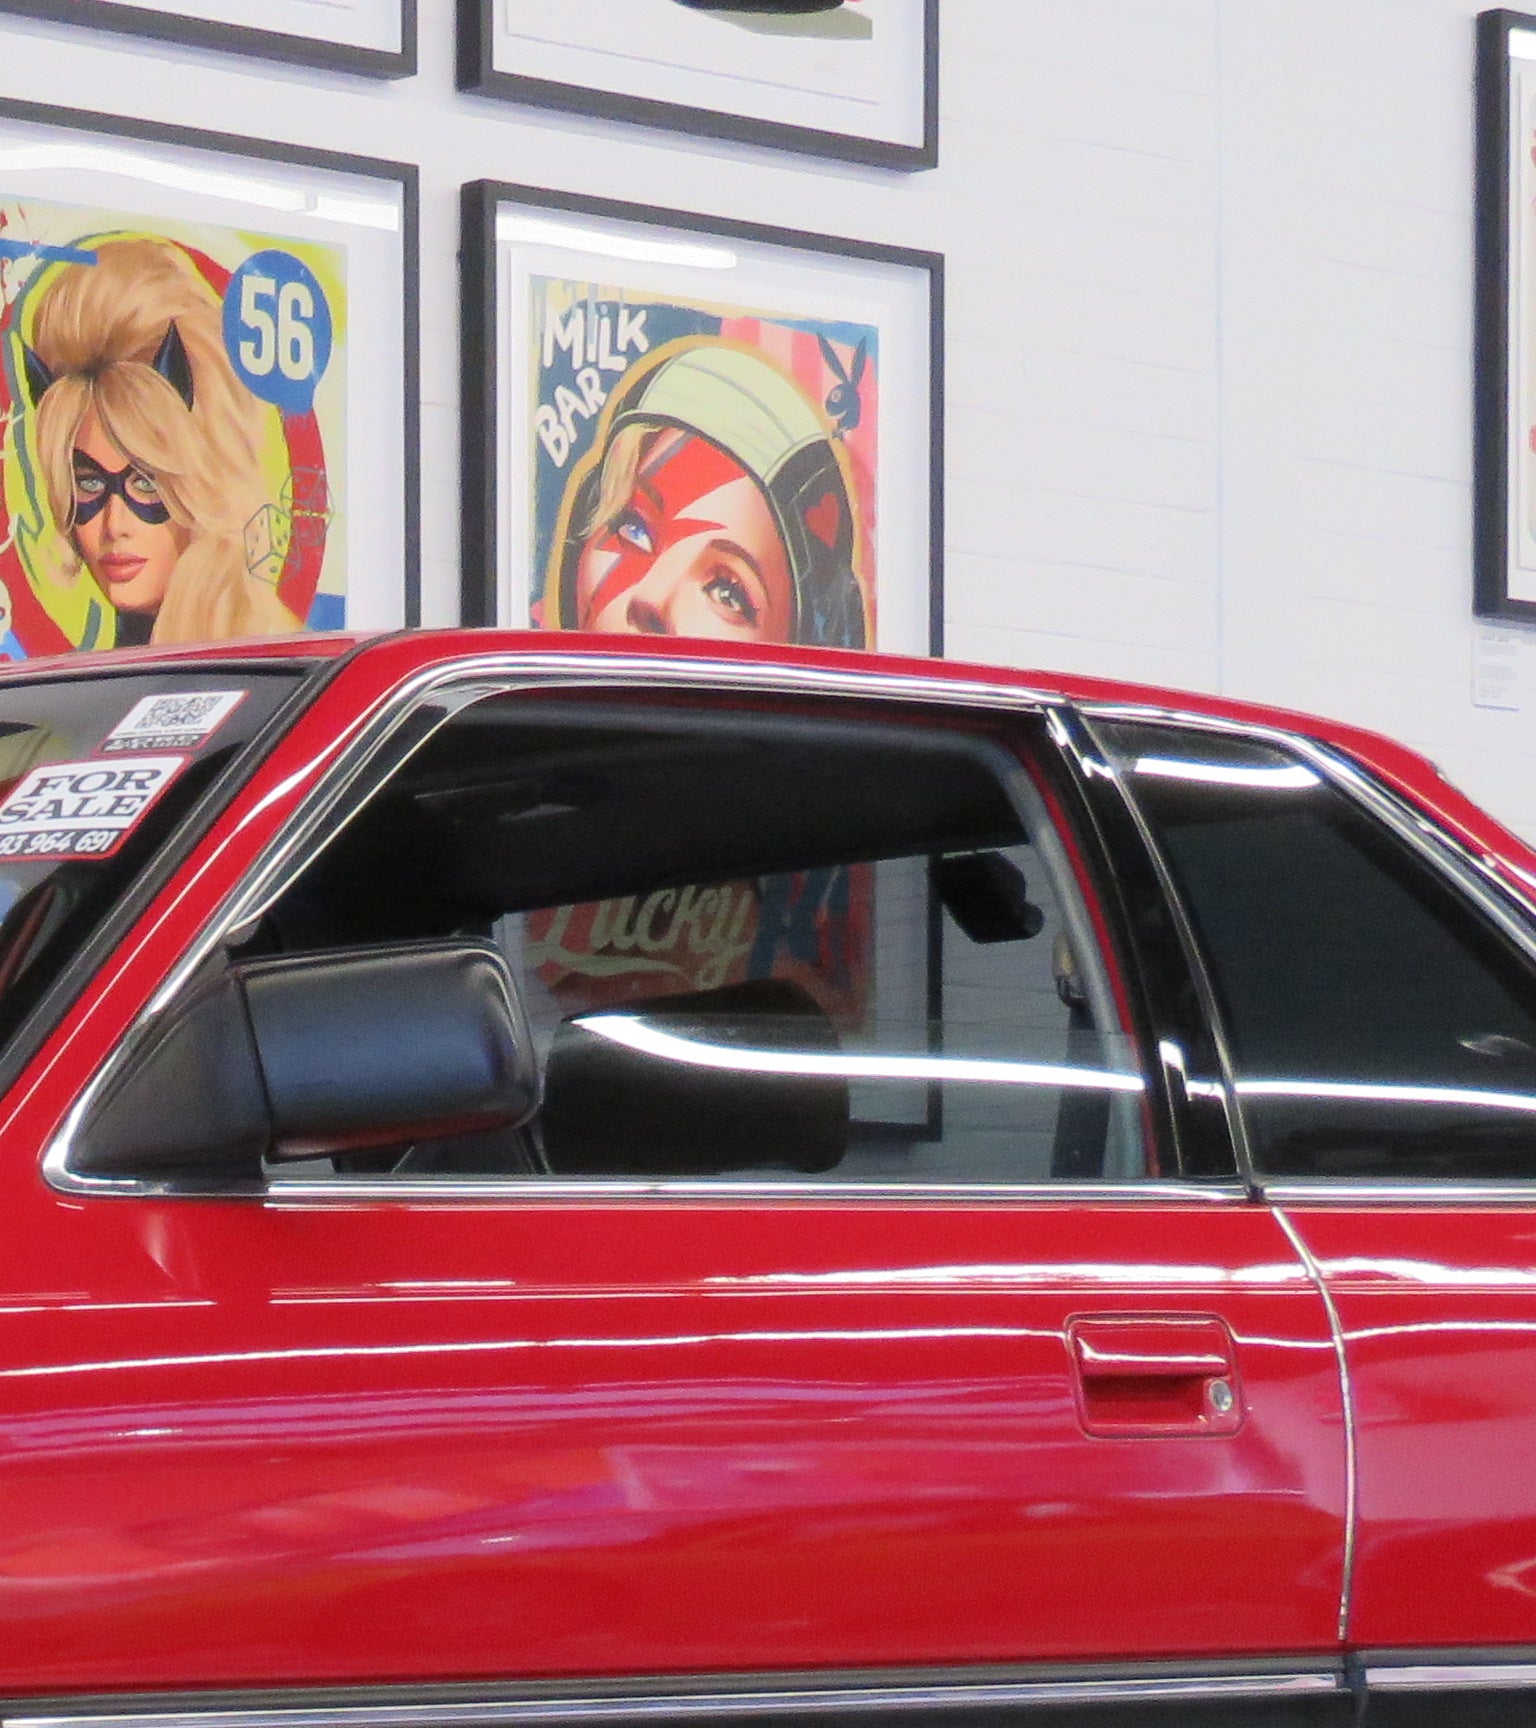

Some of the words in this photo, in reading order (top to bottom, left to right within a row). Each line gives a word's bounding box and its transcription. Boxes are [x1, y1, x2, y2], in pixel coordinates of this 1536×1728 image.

[240, 274, 314, 381] 56
[534, 367, 608, 468] BAR
[22, 769, 162, 799] FOR
[26, 833, 75, 855] 964
[75, 830, 120, 852] 691
